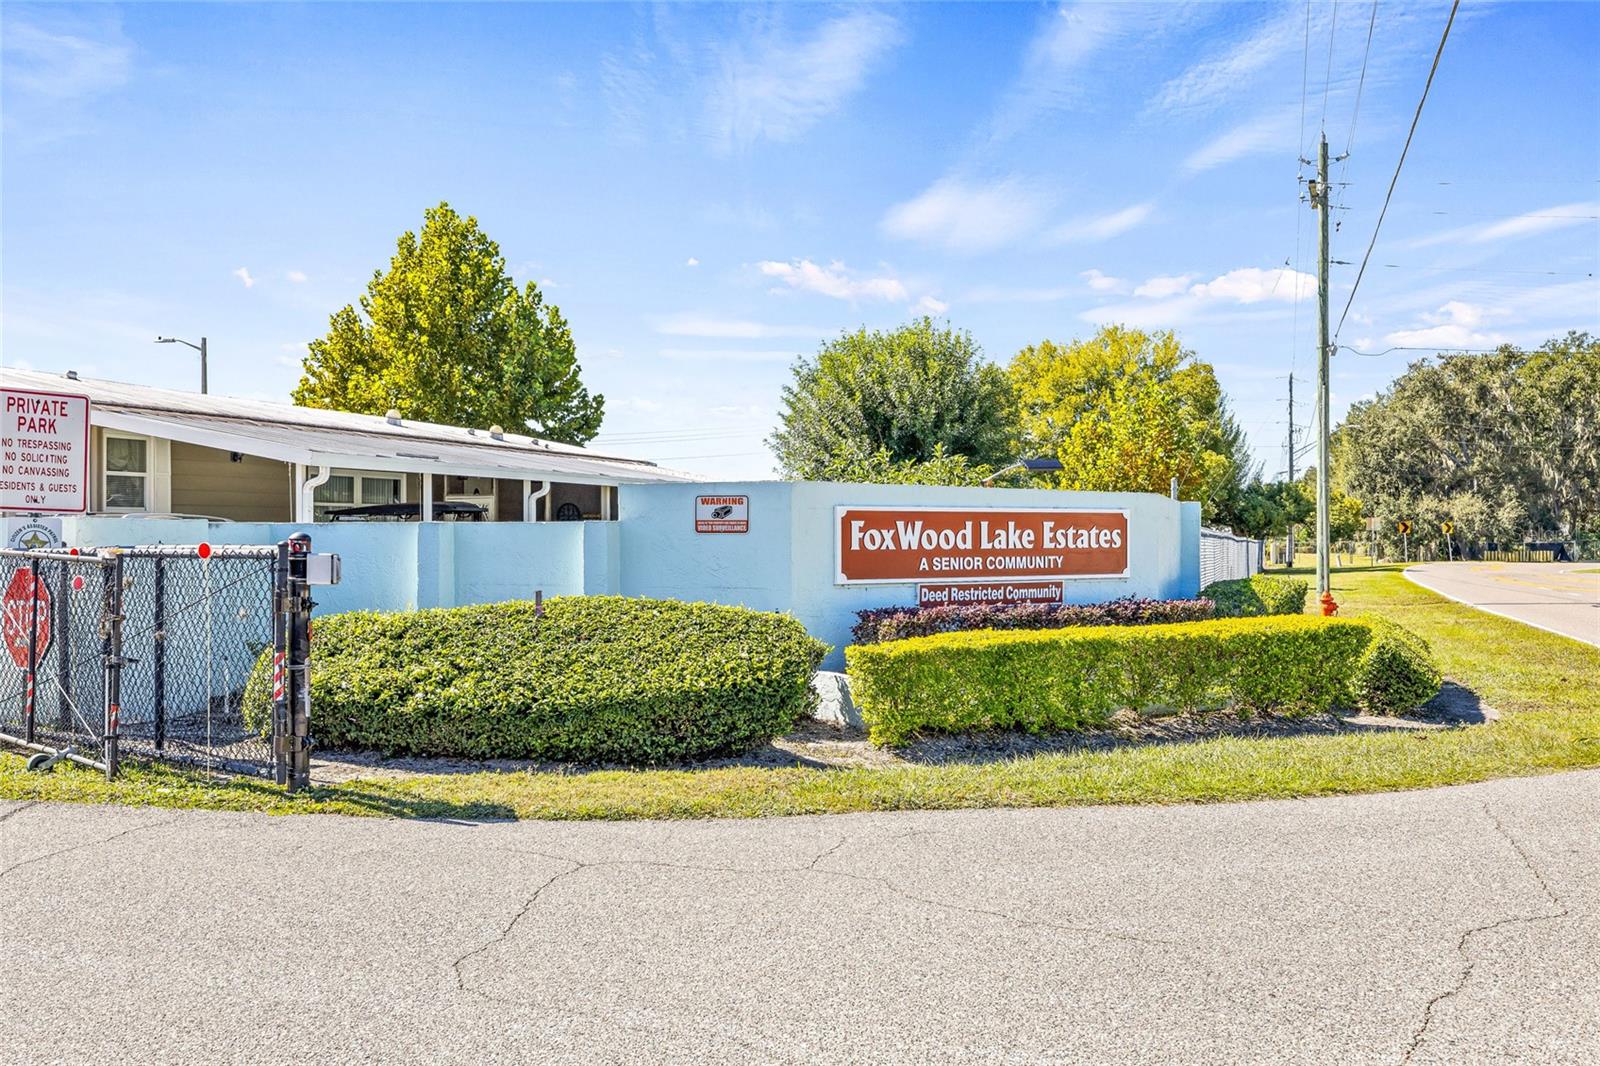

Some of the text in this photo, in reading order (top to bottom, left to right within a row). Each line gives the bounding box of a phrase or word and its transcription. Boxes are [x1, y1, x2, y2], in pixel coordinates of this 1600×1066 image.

[7, 396, 68, 417] PRIVATE
[17, 416, 57, 434] PARK
[1, 437, 72, 451] NO TRESPASSING
[4, 452, 67, 464] NO SOLICITING
[2, 465, 70, 477] NO CANVASSING
[0, 481, 78, 494] ESIDENTS & GUESTS
[25, 494, 46, 504] ONLY
[701, 498, 744, 506] WARNING
[849, 520, 1123, 551] FoxWood Lake Estates
[919, 555, 1064, 571] A SENIOR COMMUNITY
[920, 583, 1062, 602] Deed Restricted Community
[7, 600, 47, 636] STP
